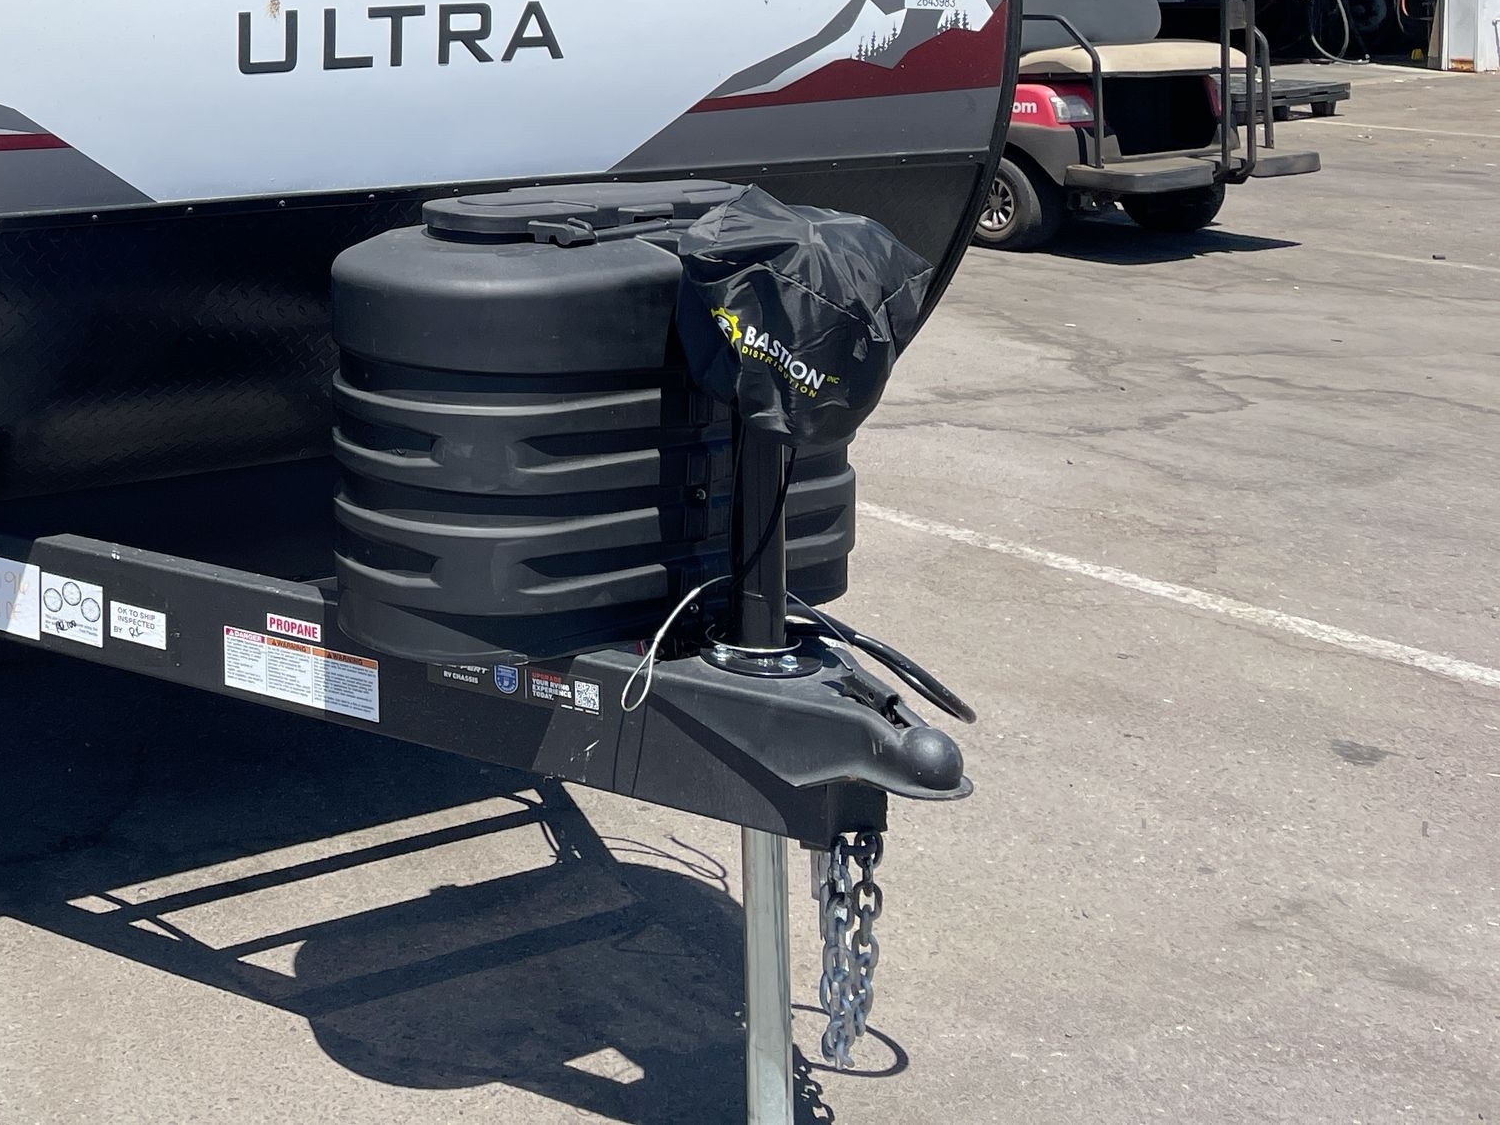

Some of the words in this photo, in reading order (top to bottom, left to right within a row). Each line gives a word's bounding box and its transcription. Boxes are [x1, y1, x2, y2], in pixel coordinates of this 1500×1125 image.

[238, 0, 564, 75] ULTRA
[1012, 101, 1038, 114] om
[744, 325, 826, 390] BASTION
[826, 375, 840, 384] INC
[741, 345, 818, 398] DISTRIBUTION
[117, 607, 128, 615] OK
[129, 609, 139, 618] TO
[139, 612, 156, 621] SHIP
[117, 615, 155, 630] INSPECTED
[269, 616, 318, 639] PROPANE
[113, 625, 123, 634] BY
[234, 630, 263, 643] DANGER
[277, 640, 307, 653] WARNING
[331, 652, 363, 665] WARNING
[443, 670, 452, 678] RV
[452, 672, 479, 684] CHASSIS
[531, 672, 562, 683] UPGRADE
[531, 678, 549, 687] YOUR
[531, 684, 572, 699] EXPERIENCE
[532, 690, 554, 701] TODAY.
